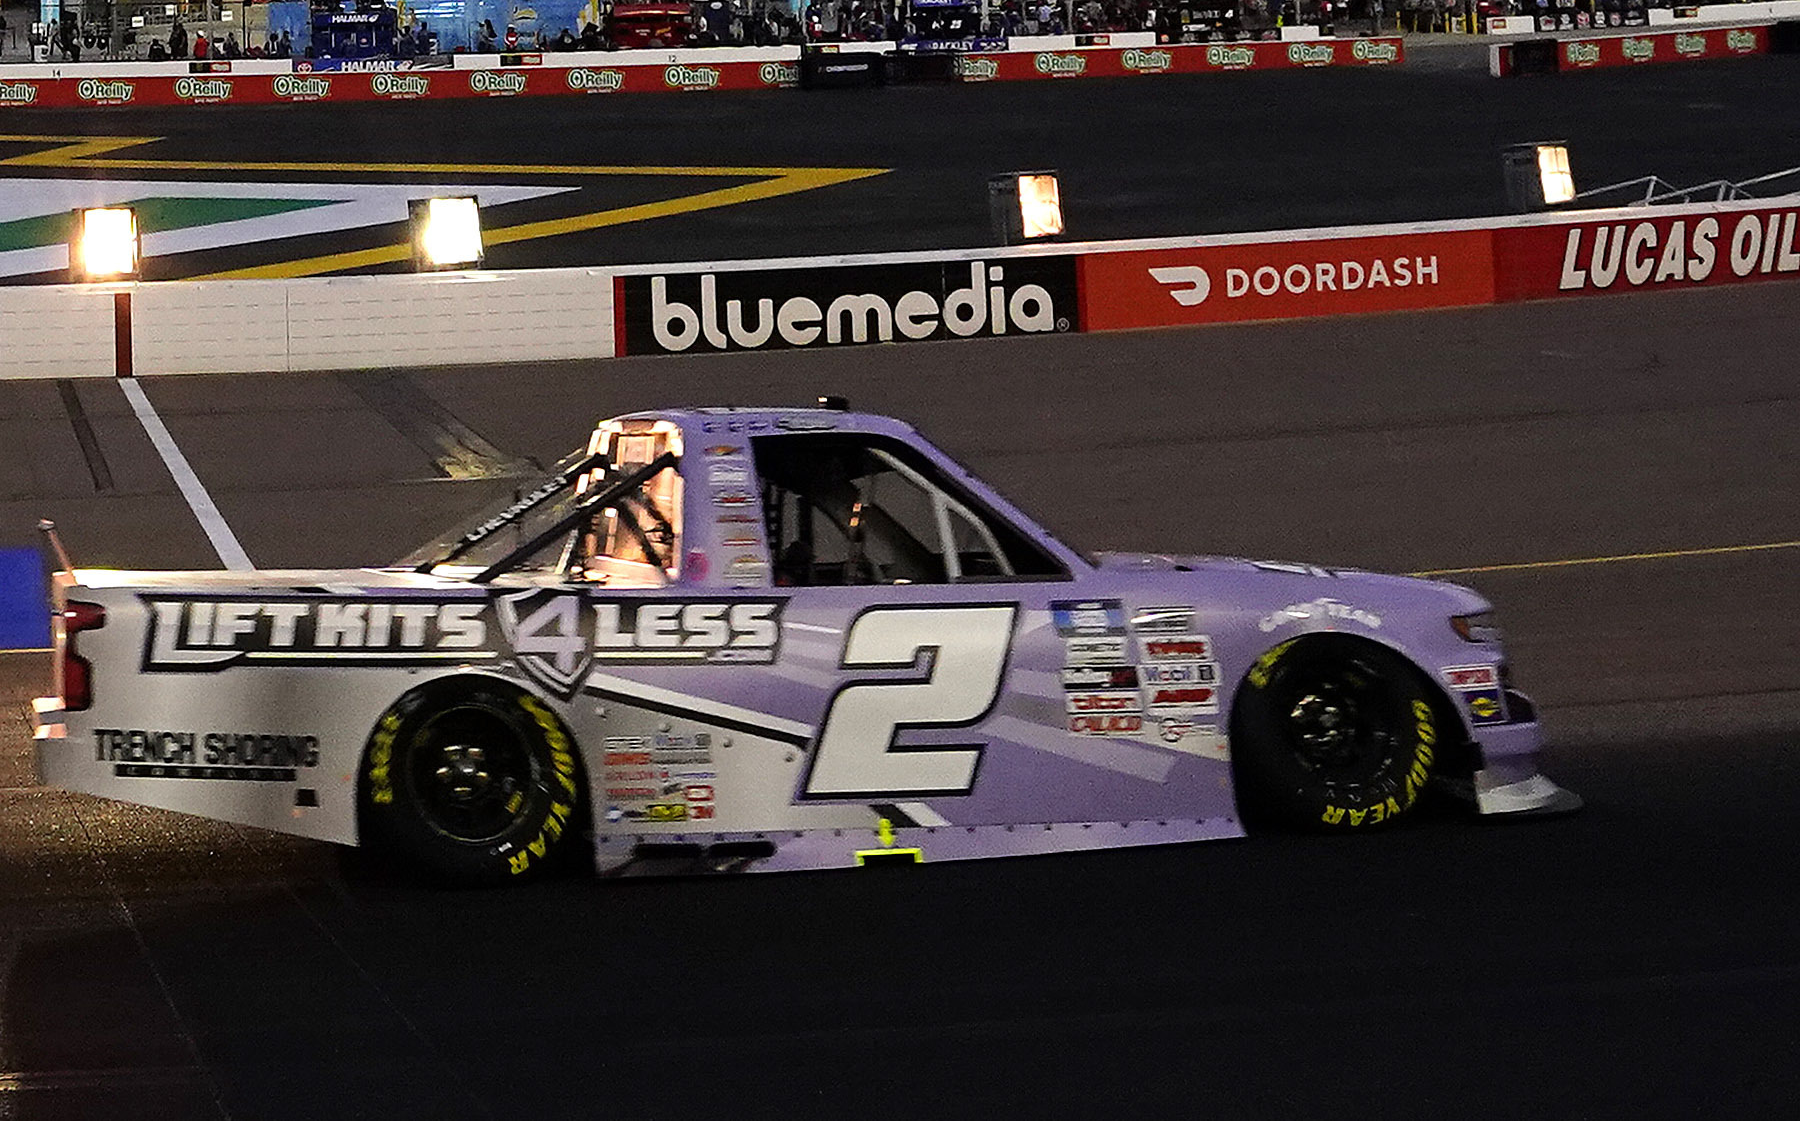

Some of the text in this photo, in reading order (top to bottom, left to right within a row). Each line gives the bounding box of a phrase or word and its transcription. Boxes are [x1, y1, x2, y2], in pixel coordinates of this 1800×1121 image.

[332, 14, 368, 24] HALMAR
[341, 61, 394, 72] HALMAR
[664, 65, 720, 87] O'Reilly
[760, 63, 799, 84] O'Rei
[77, 79, 133, 101] O'Reilly
[174, 77, 231, 100] O'Reilly
[273, 74, 331, 97] O'Reilly
[371, 72, 429, 96] O'Reilly
[470, 71, 527, 93] O'Reilly
[567, 69, 624, 89] O'Reilly
[1559, 213, 1800, 290] LUCAS OIL
[1226, 255, 1439, 298] DOORDASH
[651, 261, 1055, 352] bluemedia
[149, 594, 782, 675] LIFT KITS 4 LESS
[802, 605, 1018, 796] 2
